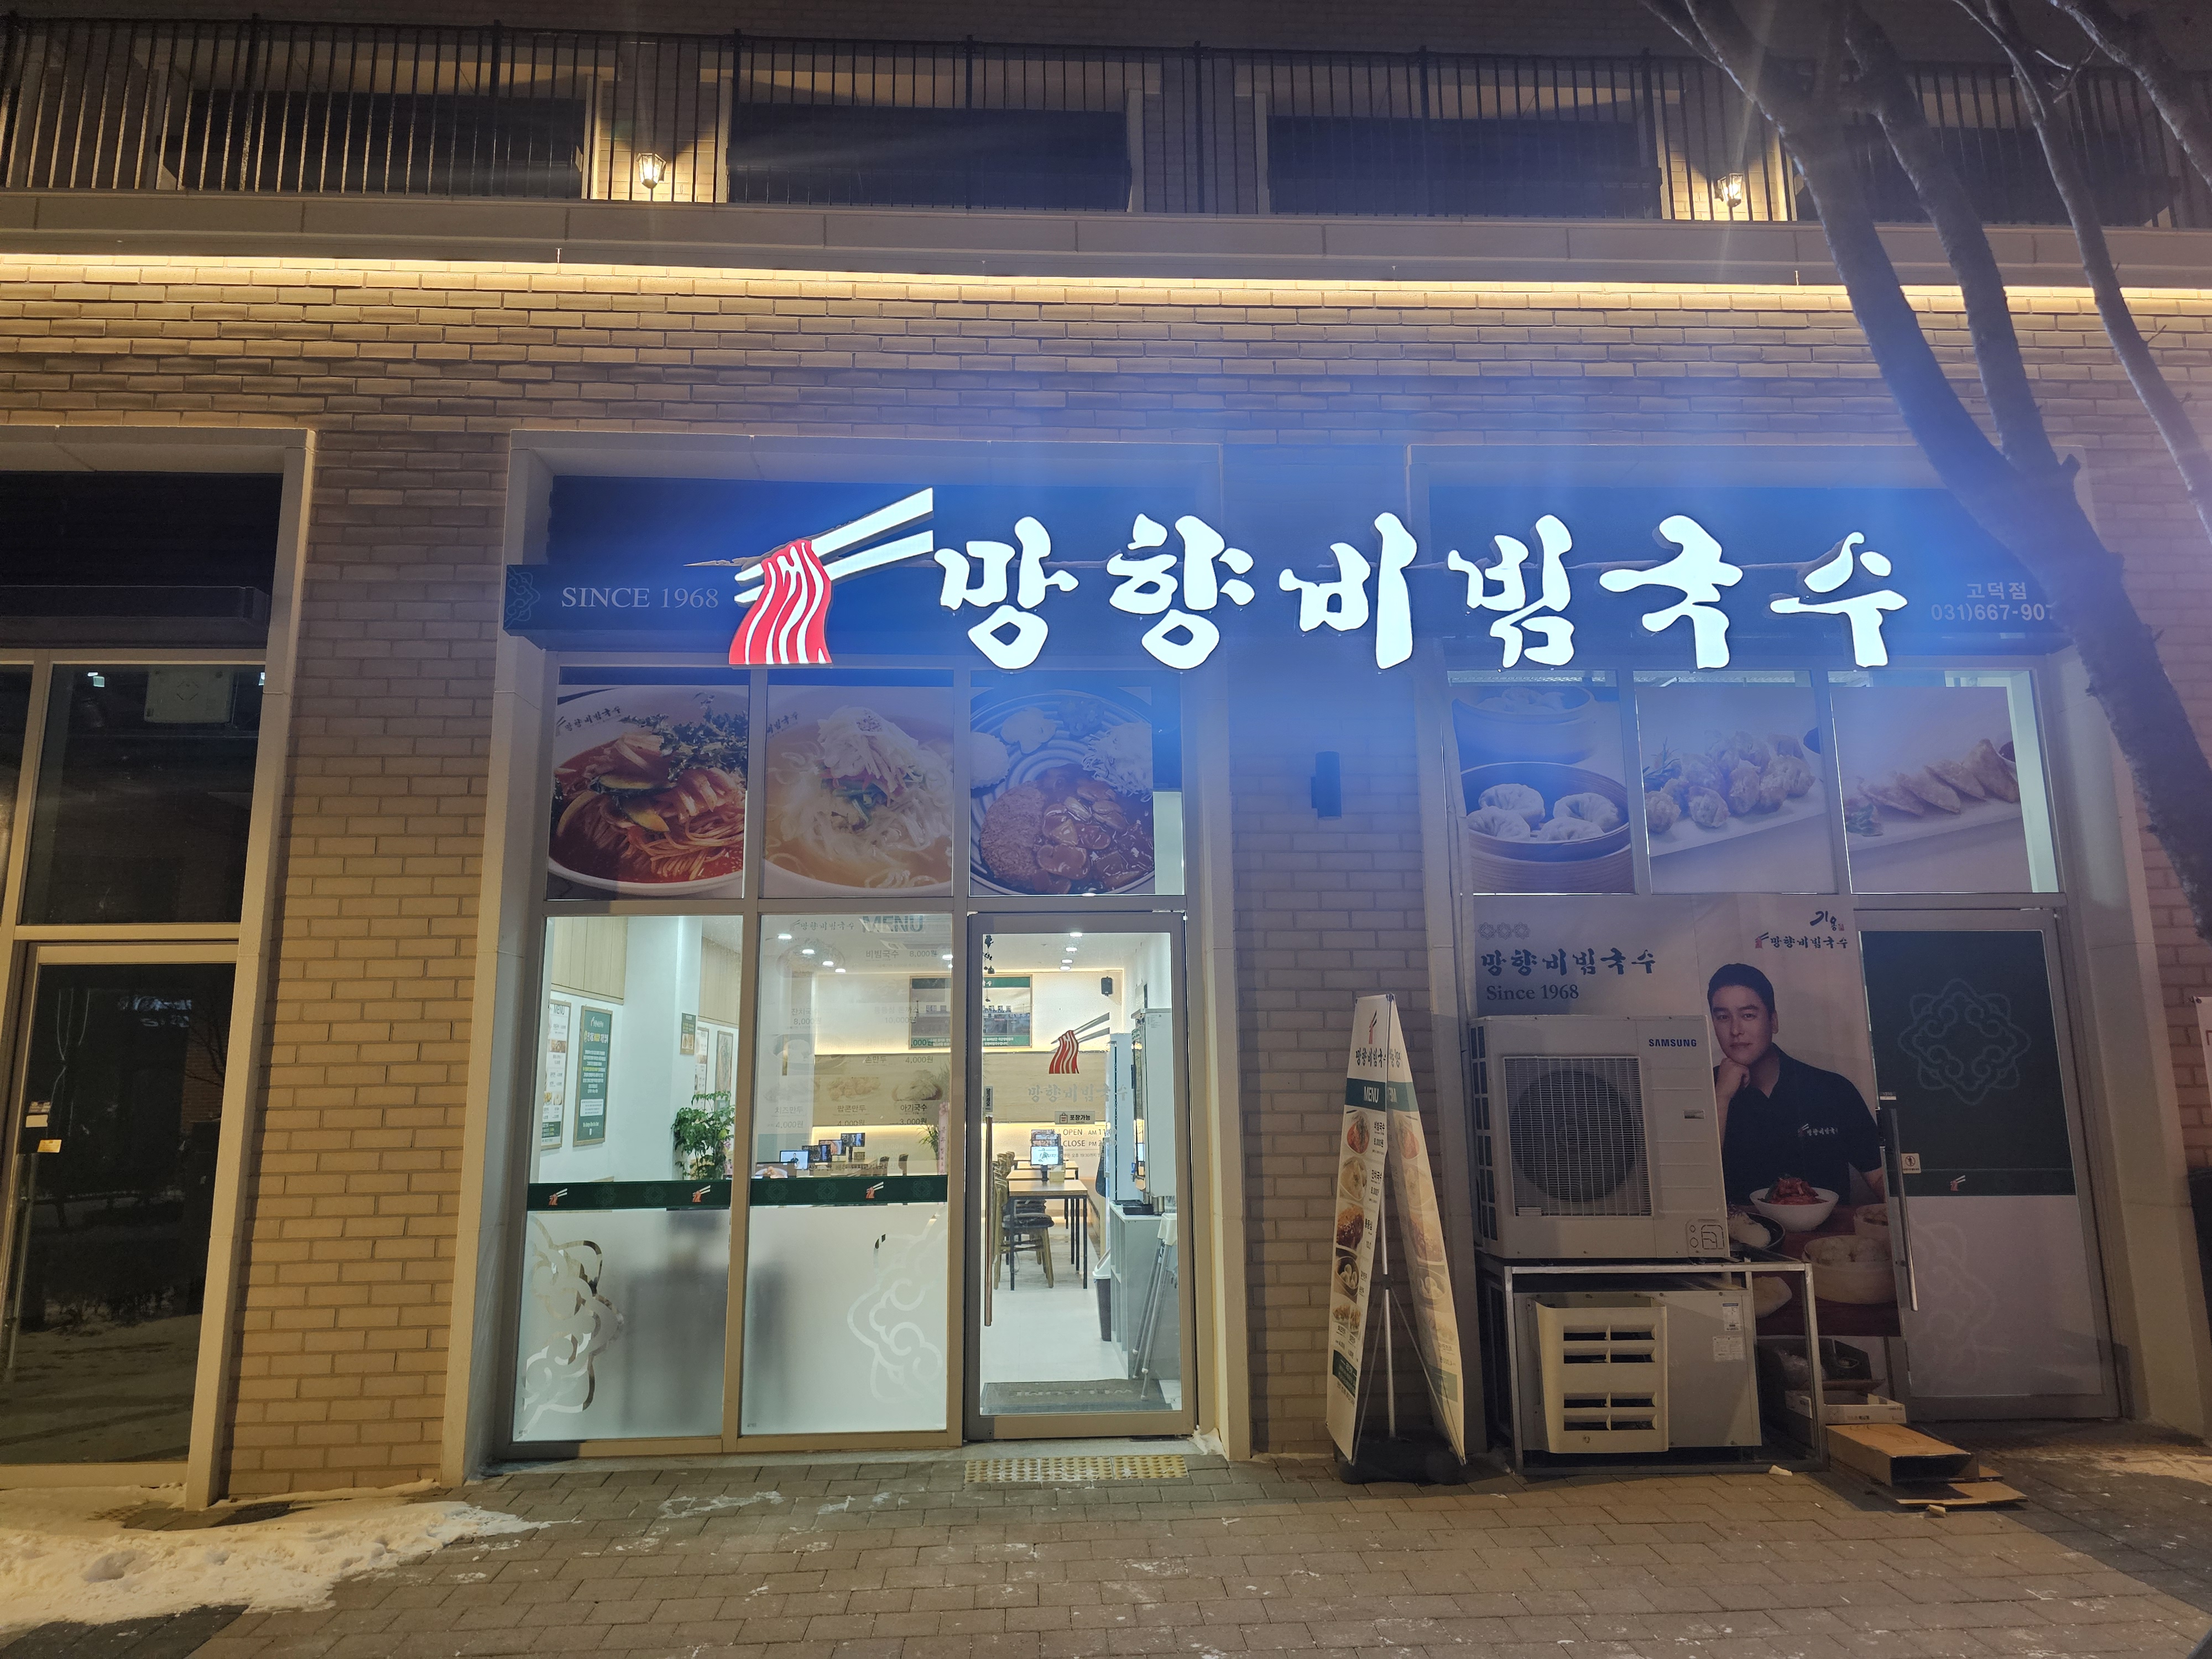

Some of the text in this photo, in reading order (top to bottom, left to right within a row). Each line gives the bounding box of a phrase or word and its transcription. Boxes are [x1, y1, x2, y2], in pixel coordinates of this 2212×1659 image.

[561, 587, 719, 609] SINCE 1968
[933, 512, 1909, 670] 망향비빔국수
[1966, 582, 2027, 600] 고덕점
[862, 915, 923, 933] MENU
[1770, 936, 1848, 949] 망향비빔국수
[865, 950, 900, 959] 비빔국수
[1480, 947, 1656, 976] 망향비빔국수
[1486, 984, 1579, 1000] Since 1968
[1648, 1039, 1697, 1047] SAMSUNG
[864, 1055, 887, 1063] 손만두
[1028, 1083, 1128, 1103] 망향비빔국수
[1364, 1086, 1379, 1103] MENU
